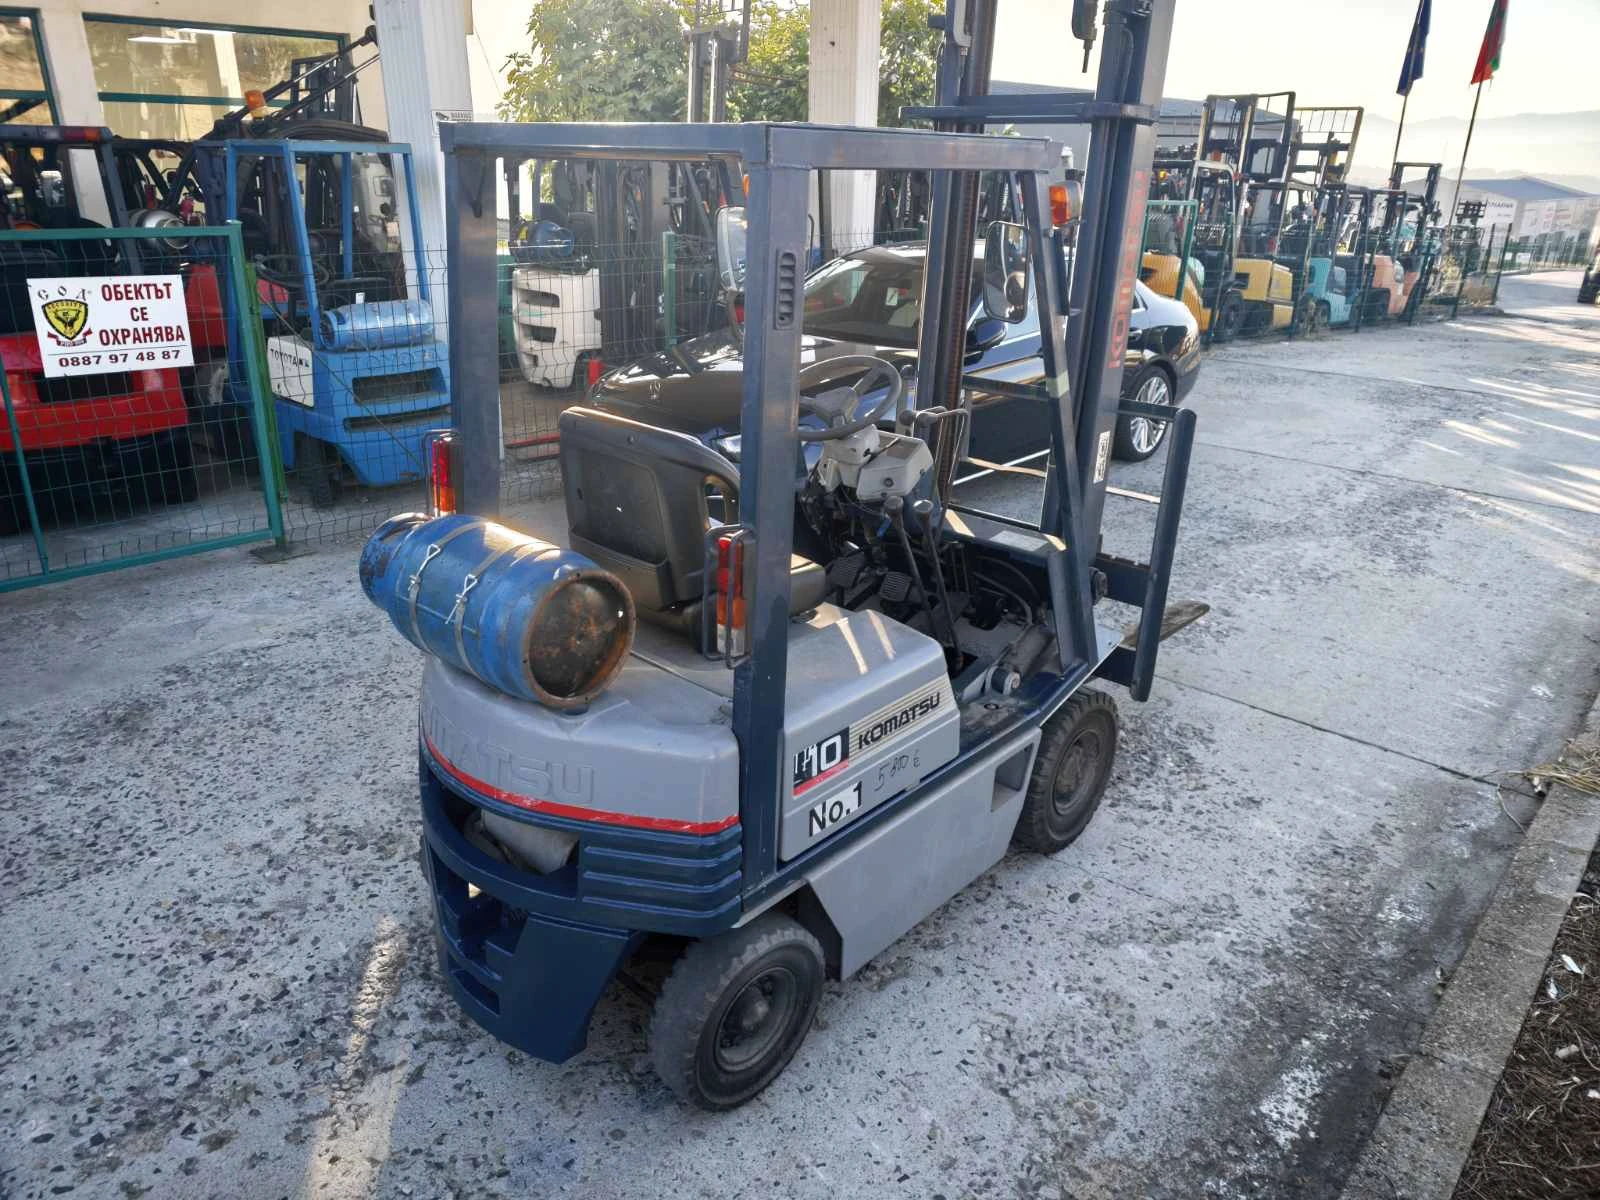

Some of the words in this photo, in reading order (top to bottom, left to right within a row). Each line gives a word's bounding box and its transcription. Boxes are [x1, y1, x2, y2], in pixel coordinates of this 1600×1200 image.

[101, 283, 172, 301] ОБЕКТЪТ
[130, 307, 149, 322] СЕ
[99, 325, 185, 346] ОХРАНЯВА
[59, 355, 102, 368] 0887
[109, 353, 128, 364] 97
[135, 351, 155, 362] 48
[162, 350, 181, 360] 87
[858, 692, 940, 749] KOMATSU
[809, 780, 862, 837] No.1
